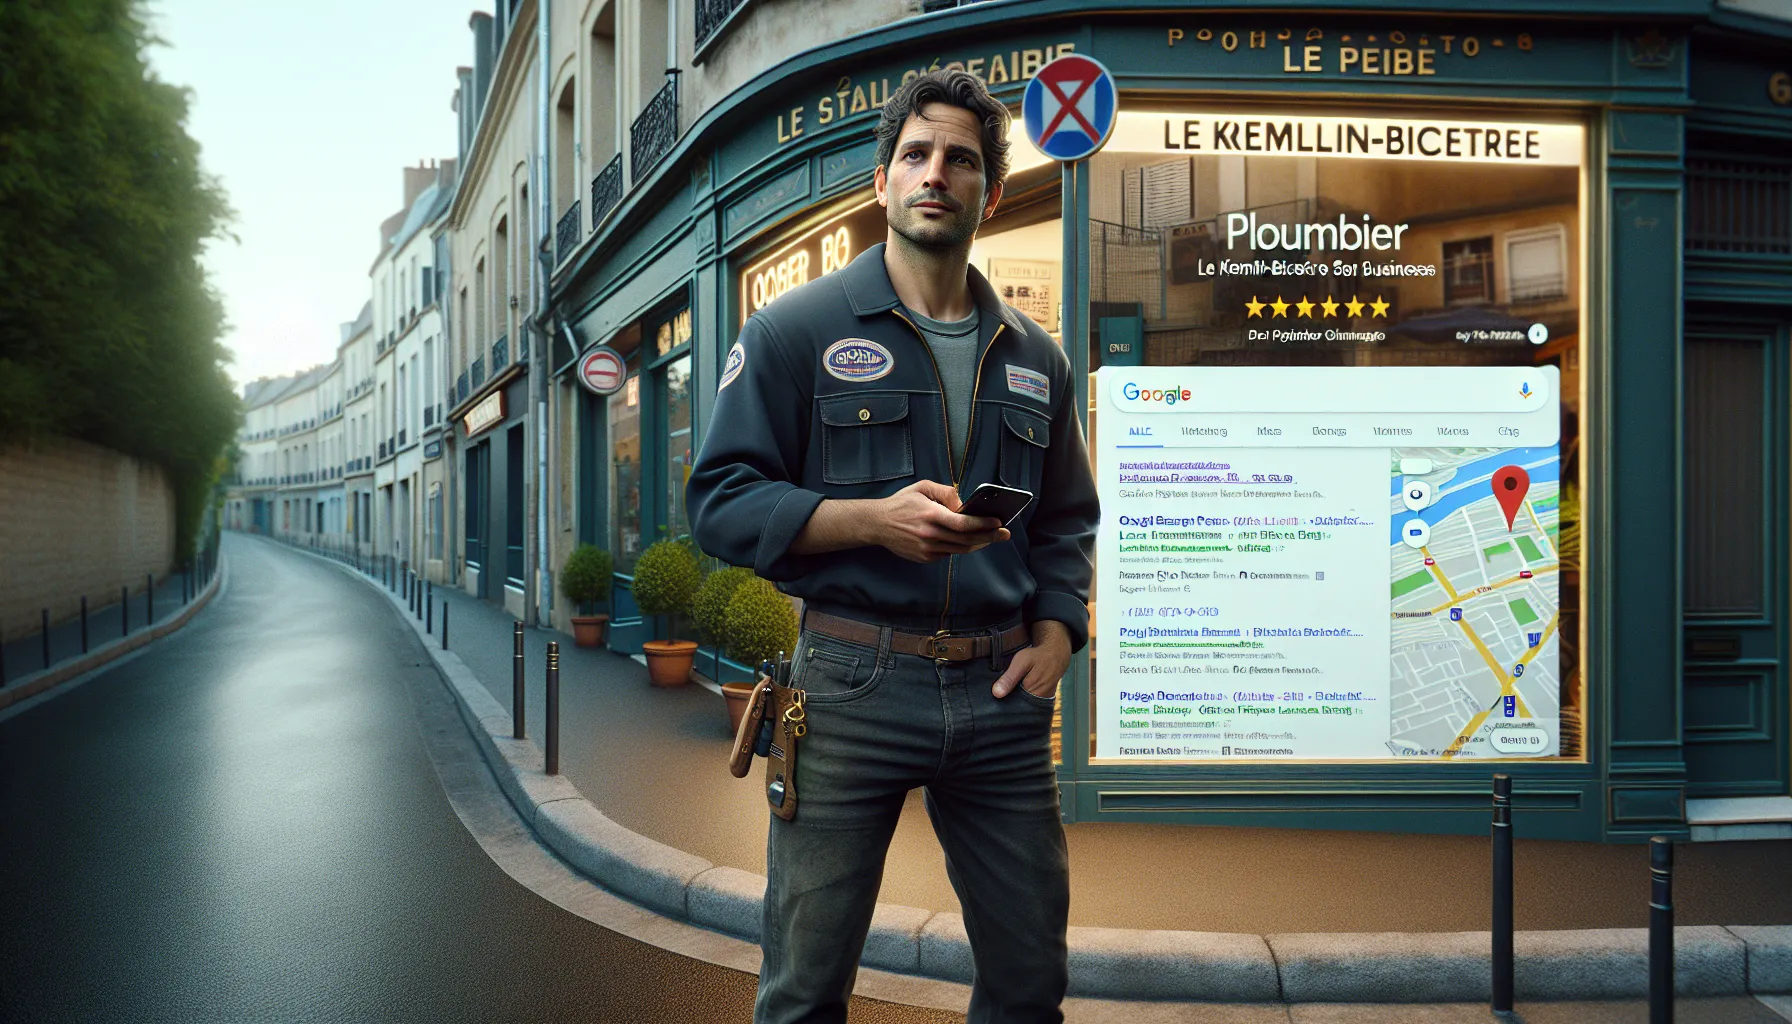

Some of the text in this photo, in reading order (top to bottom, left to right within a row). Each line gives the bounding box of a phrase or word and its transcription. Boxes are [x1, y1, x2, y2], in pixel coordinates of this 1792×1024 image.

[1283, 45, 1436, 75] LE PEIBE
[777, 105, 805, 144] LE
[1164, 120, 1201, 150] LE
[1227, 213, 1409, 250] Ploumbier
